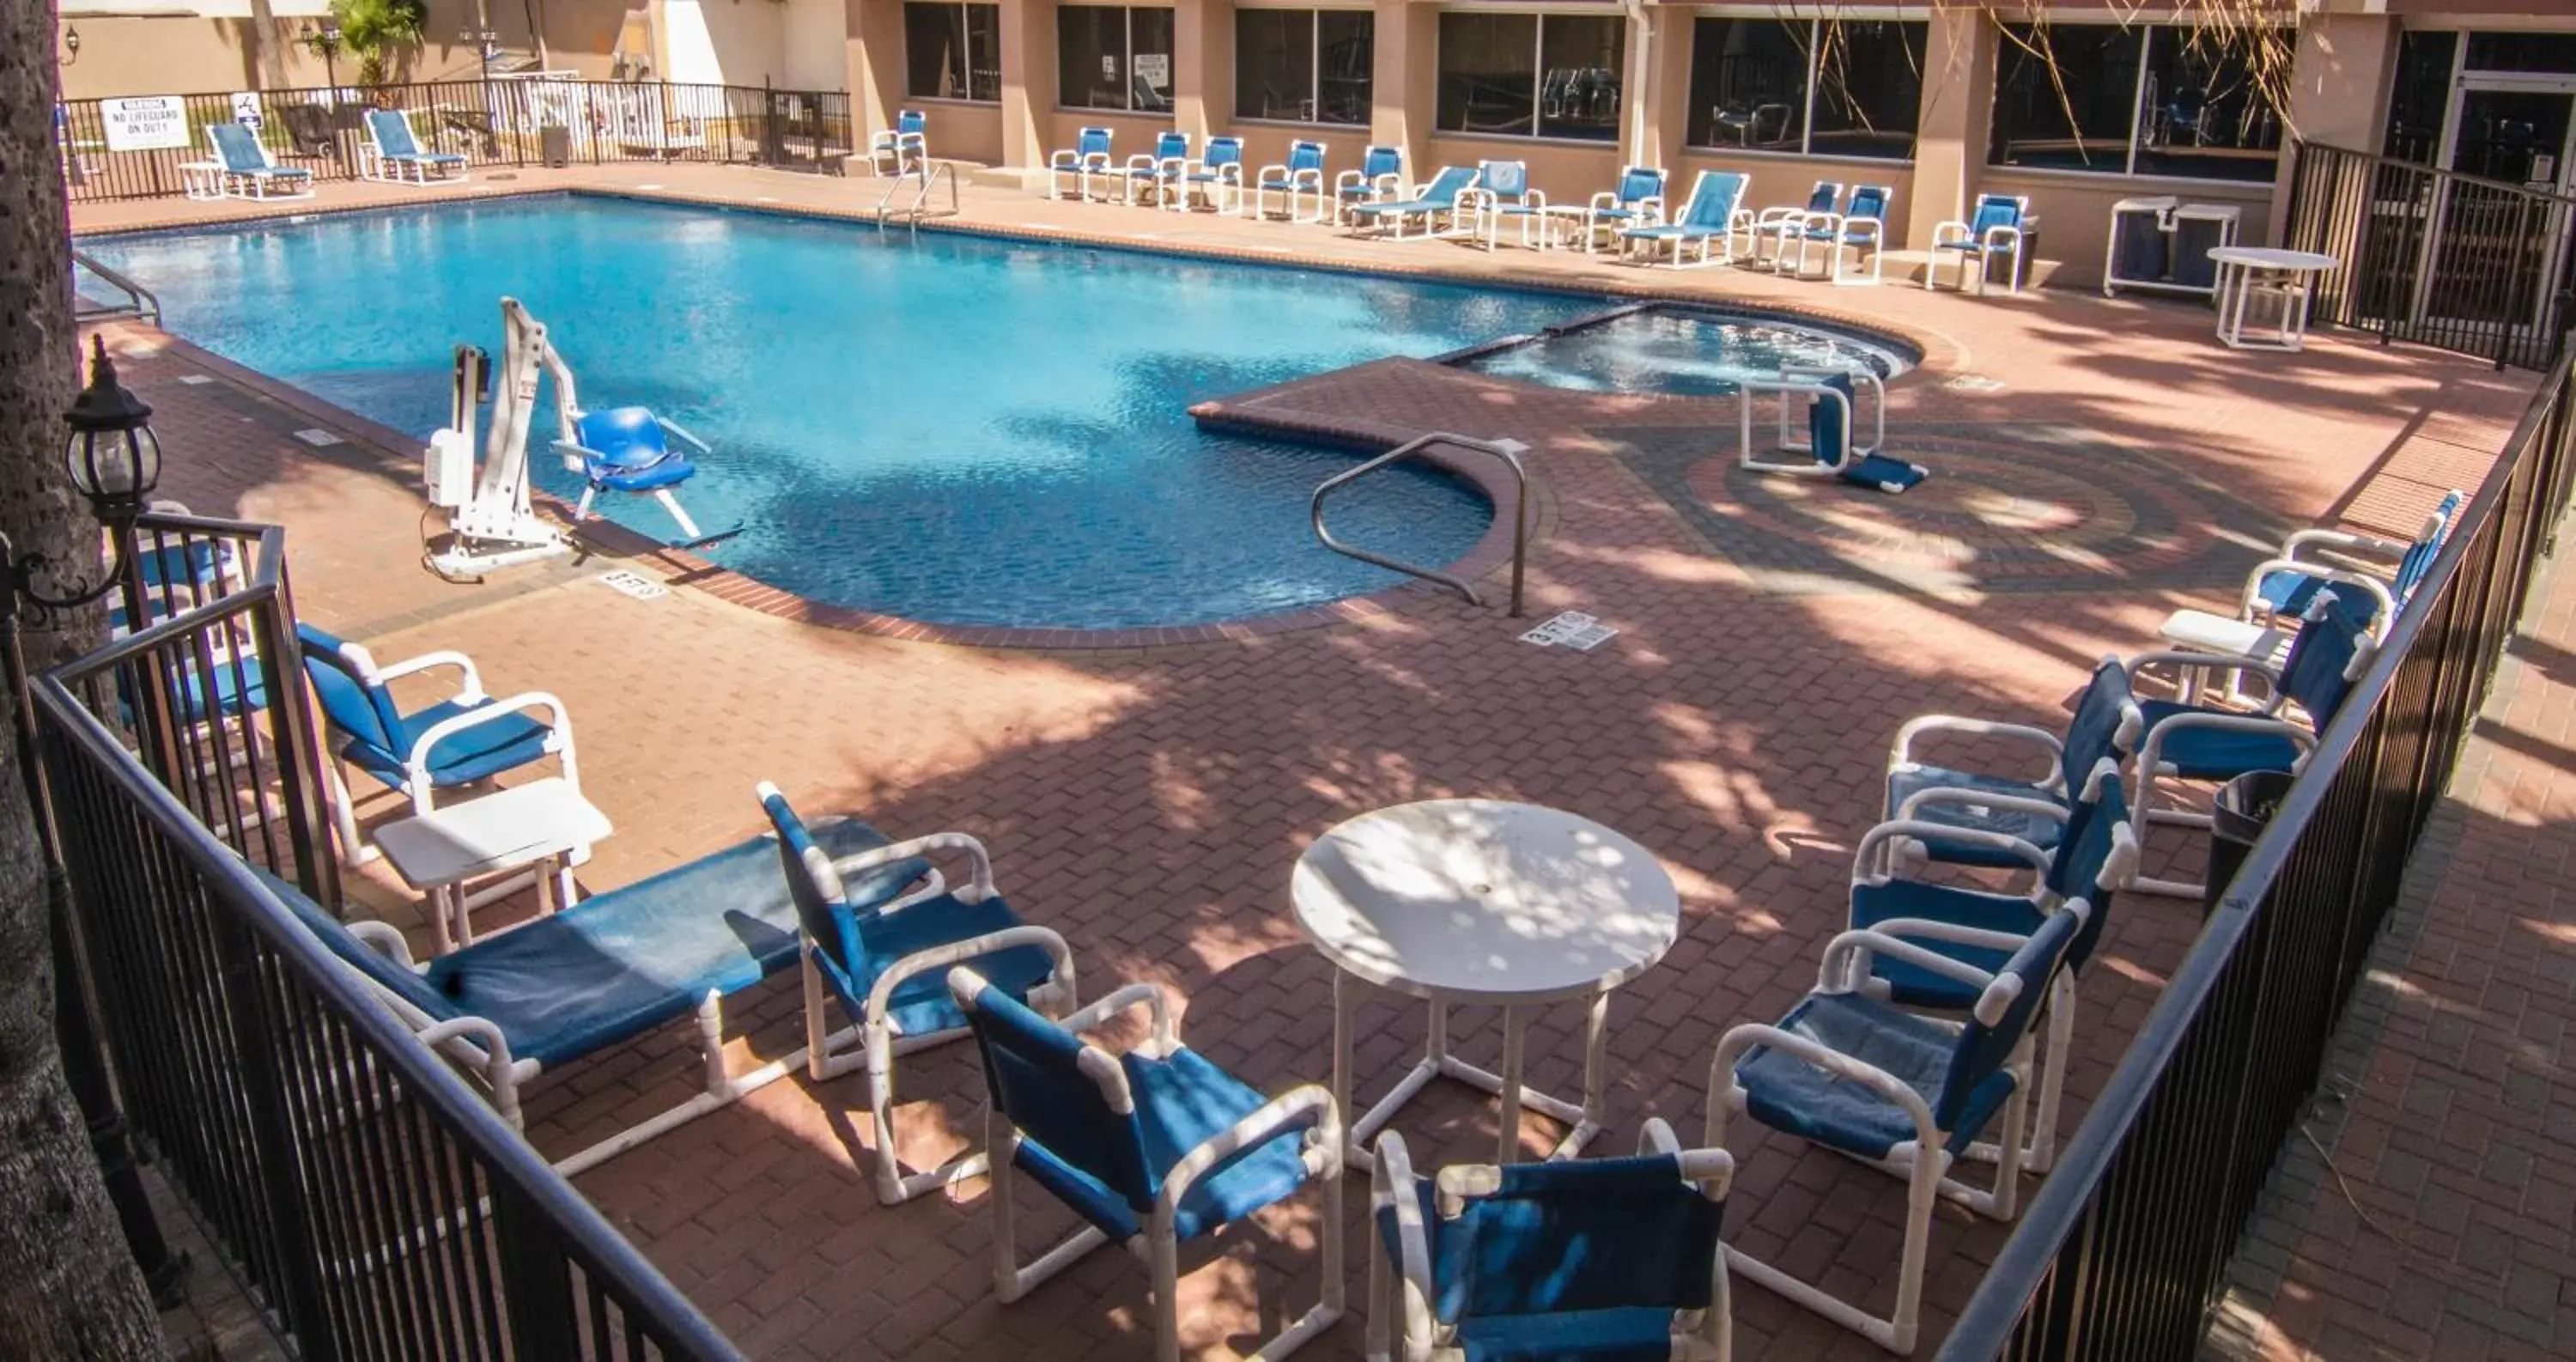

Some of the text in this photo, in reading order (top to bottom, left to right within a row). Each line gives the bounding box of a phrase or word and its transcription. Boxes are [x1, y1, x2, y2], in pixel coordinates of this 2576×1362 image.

[112, 109, 179, 123] NO LIFEGUARD
[128, 122, 168, 134] ON DUTY
